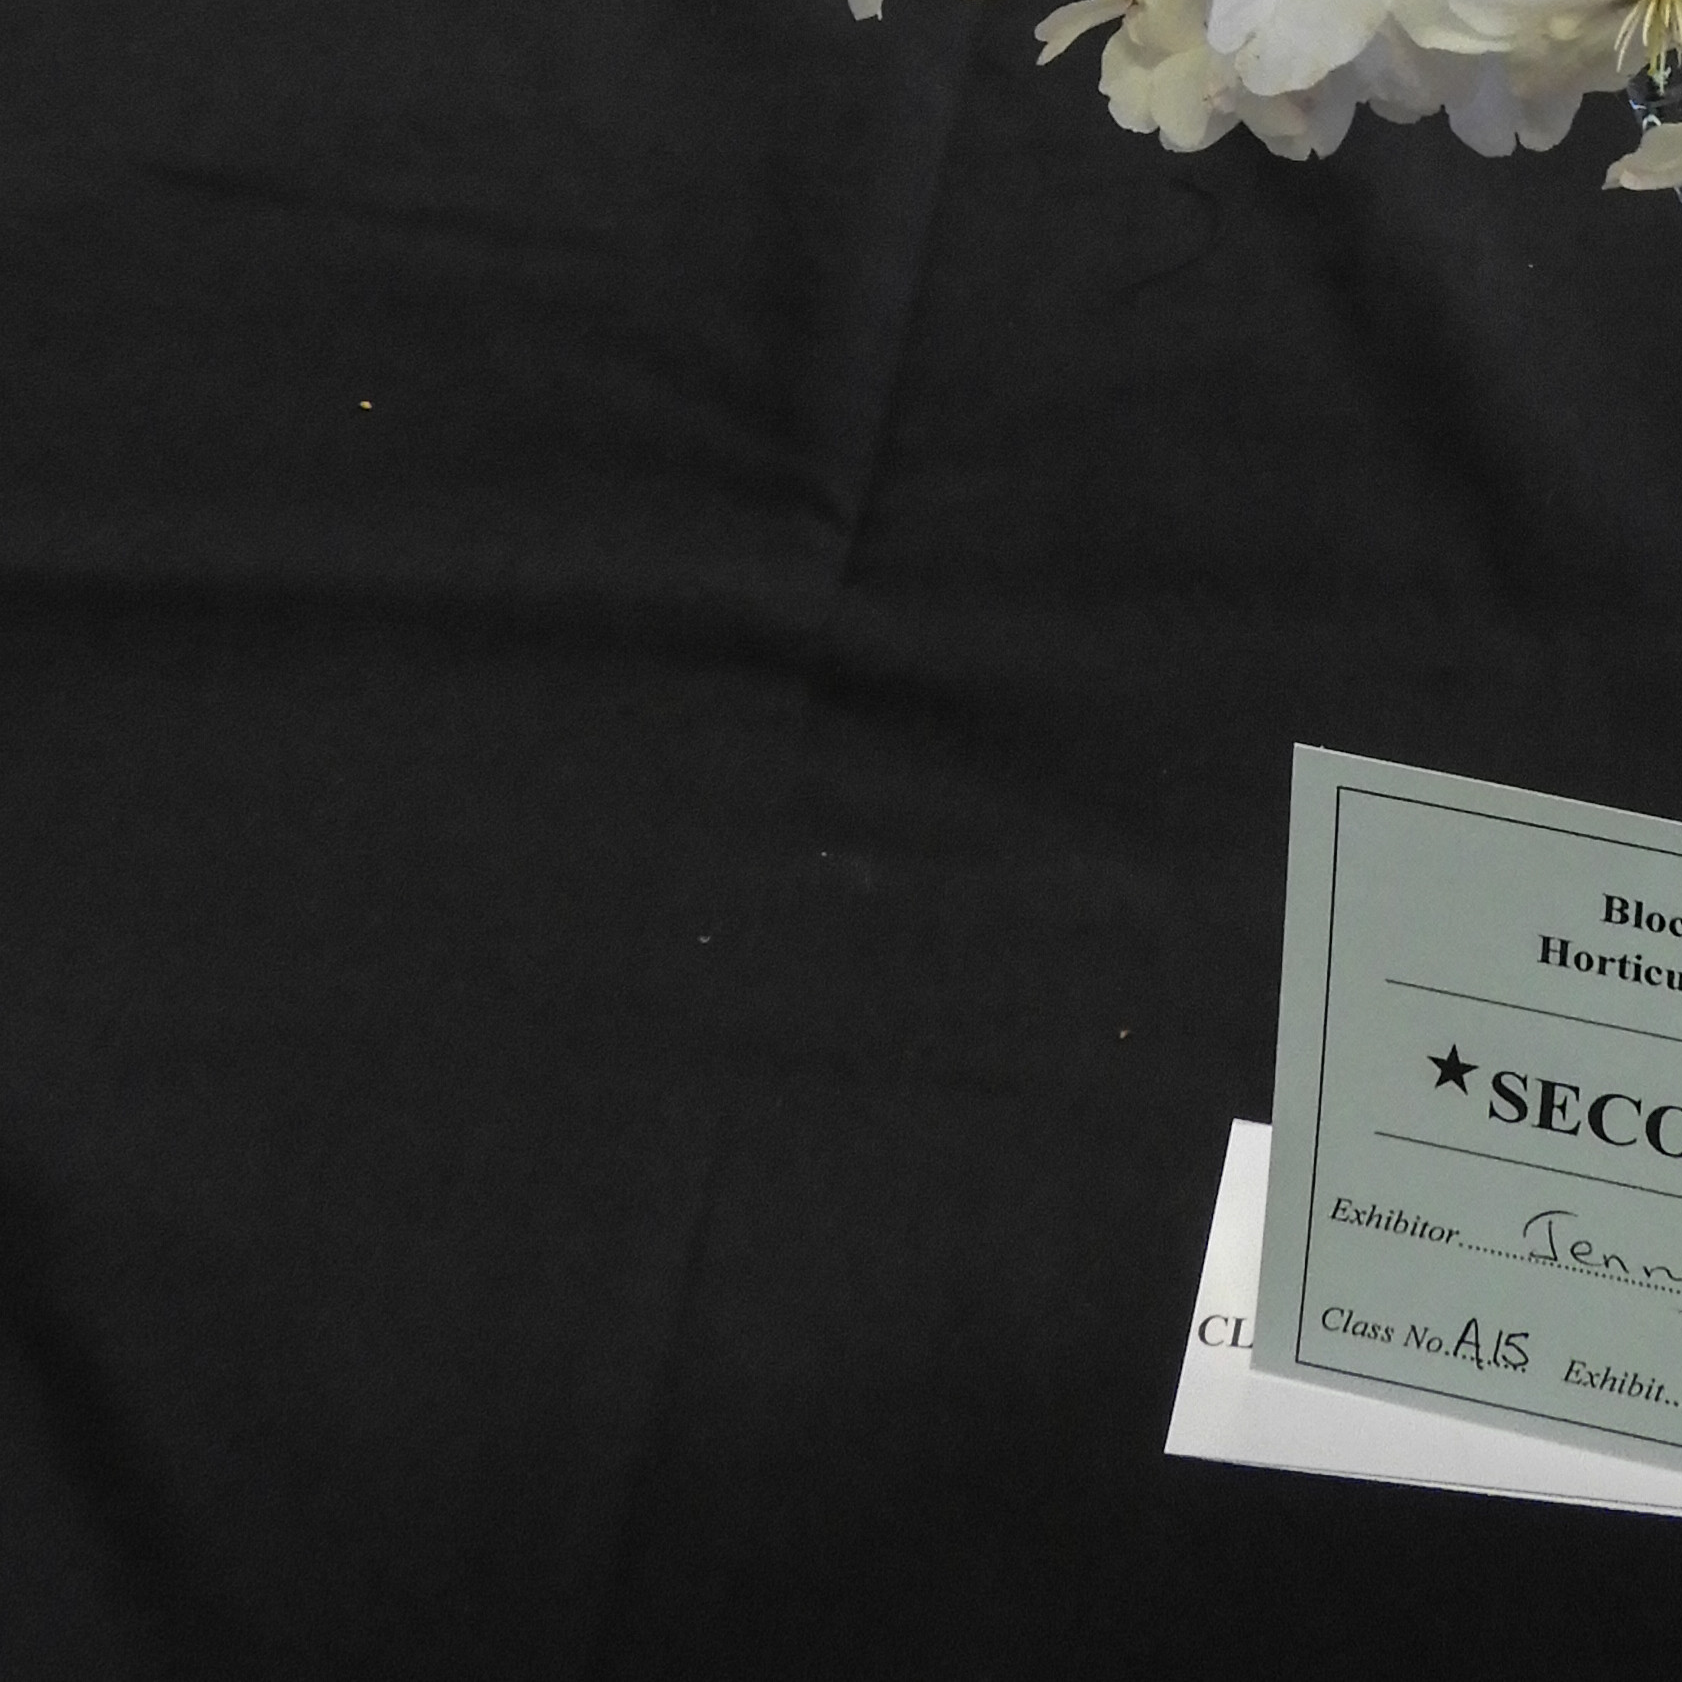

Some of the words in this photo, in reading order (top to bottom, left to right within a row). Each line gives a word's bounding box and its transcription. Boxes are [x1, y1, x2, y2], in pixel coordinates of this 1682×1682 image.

[1328, 1197, 1460, 1246] Exhibitor
[1320, 1306, 1395, 1344] Class
[1452, 1317, 1530, 1371] A15
[1563, 1359, 1666, 1403] Exhibit
